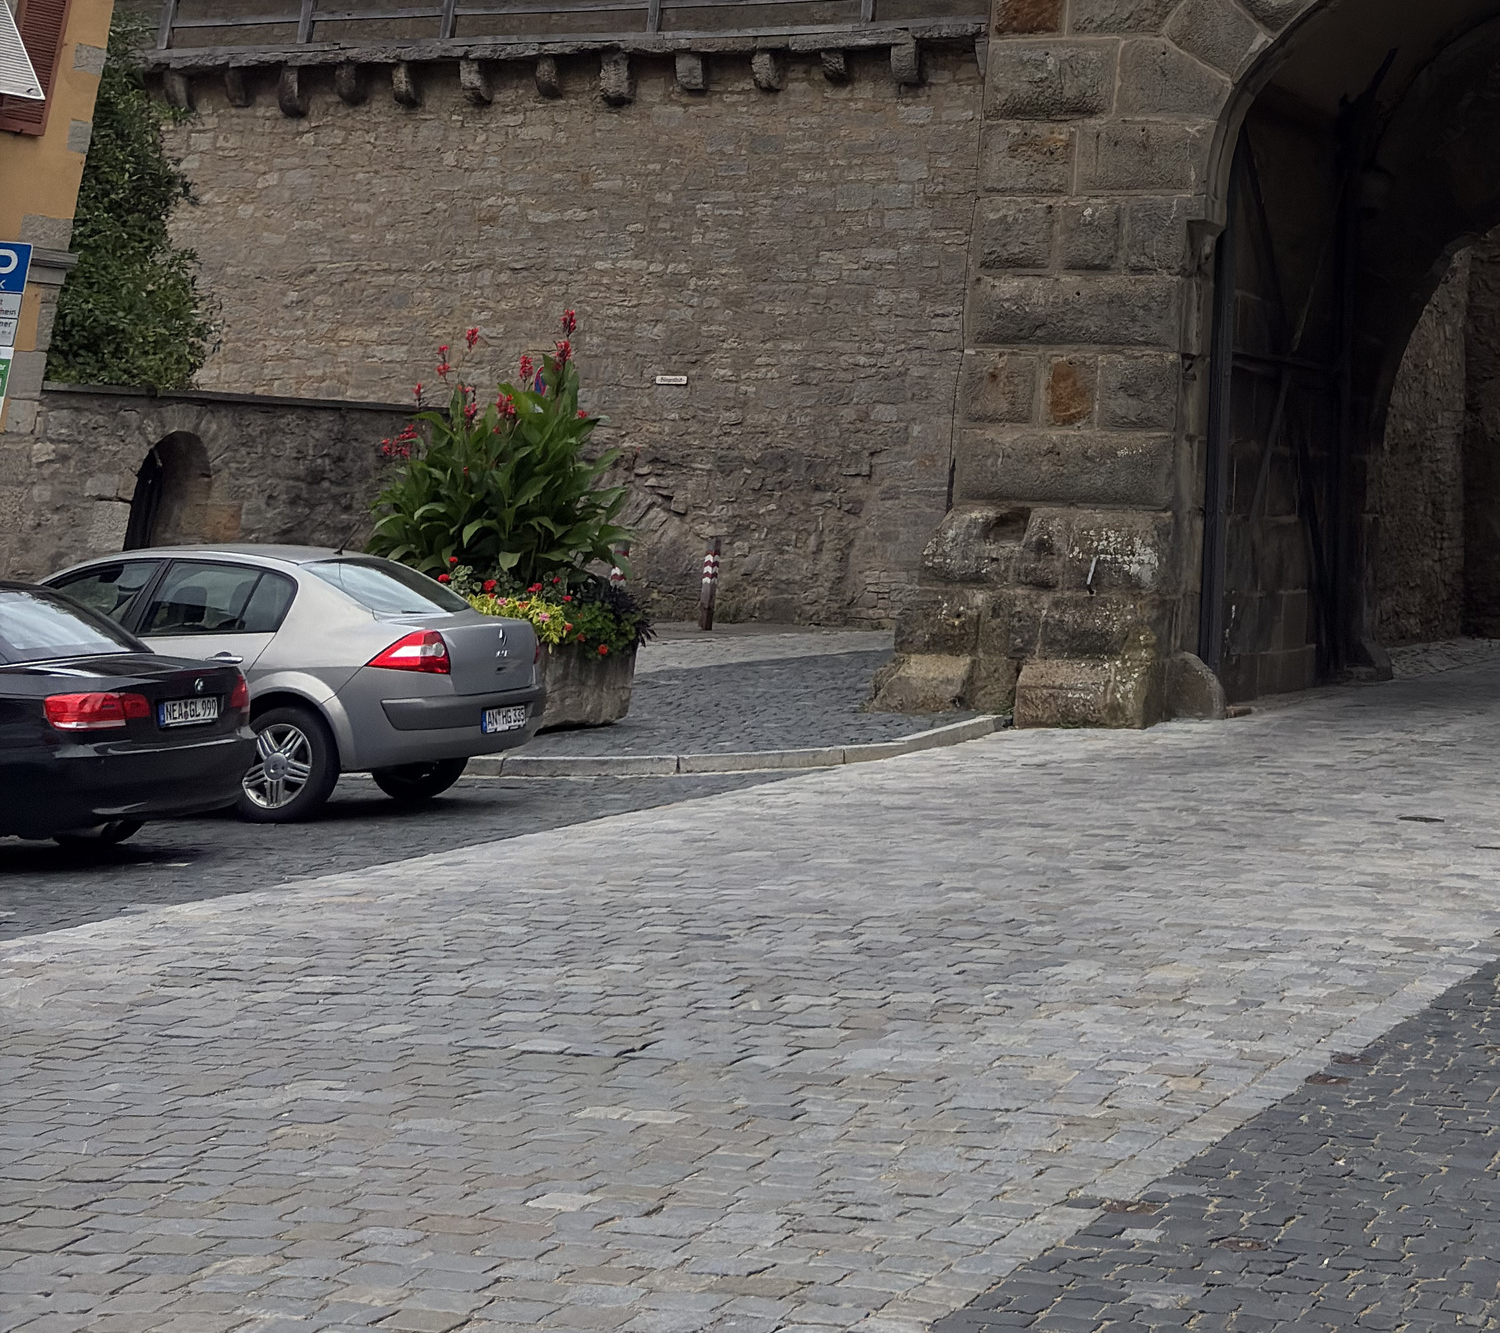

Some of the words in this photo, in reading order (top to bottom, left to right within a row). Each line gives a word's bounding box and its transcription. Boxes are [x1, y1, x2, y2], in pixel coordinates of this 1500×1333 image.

[165, 702, 183, 721] NEA
[190, 700, 201, 718] GL
[202, 699, 216, 717] 999
[488, 711, 498, 727] AN
